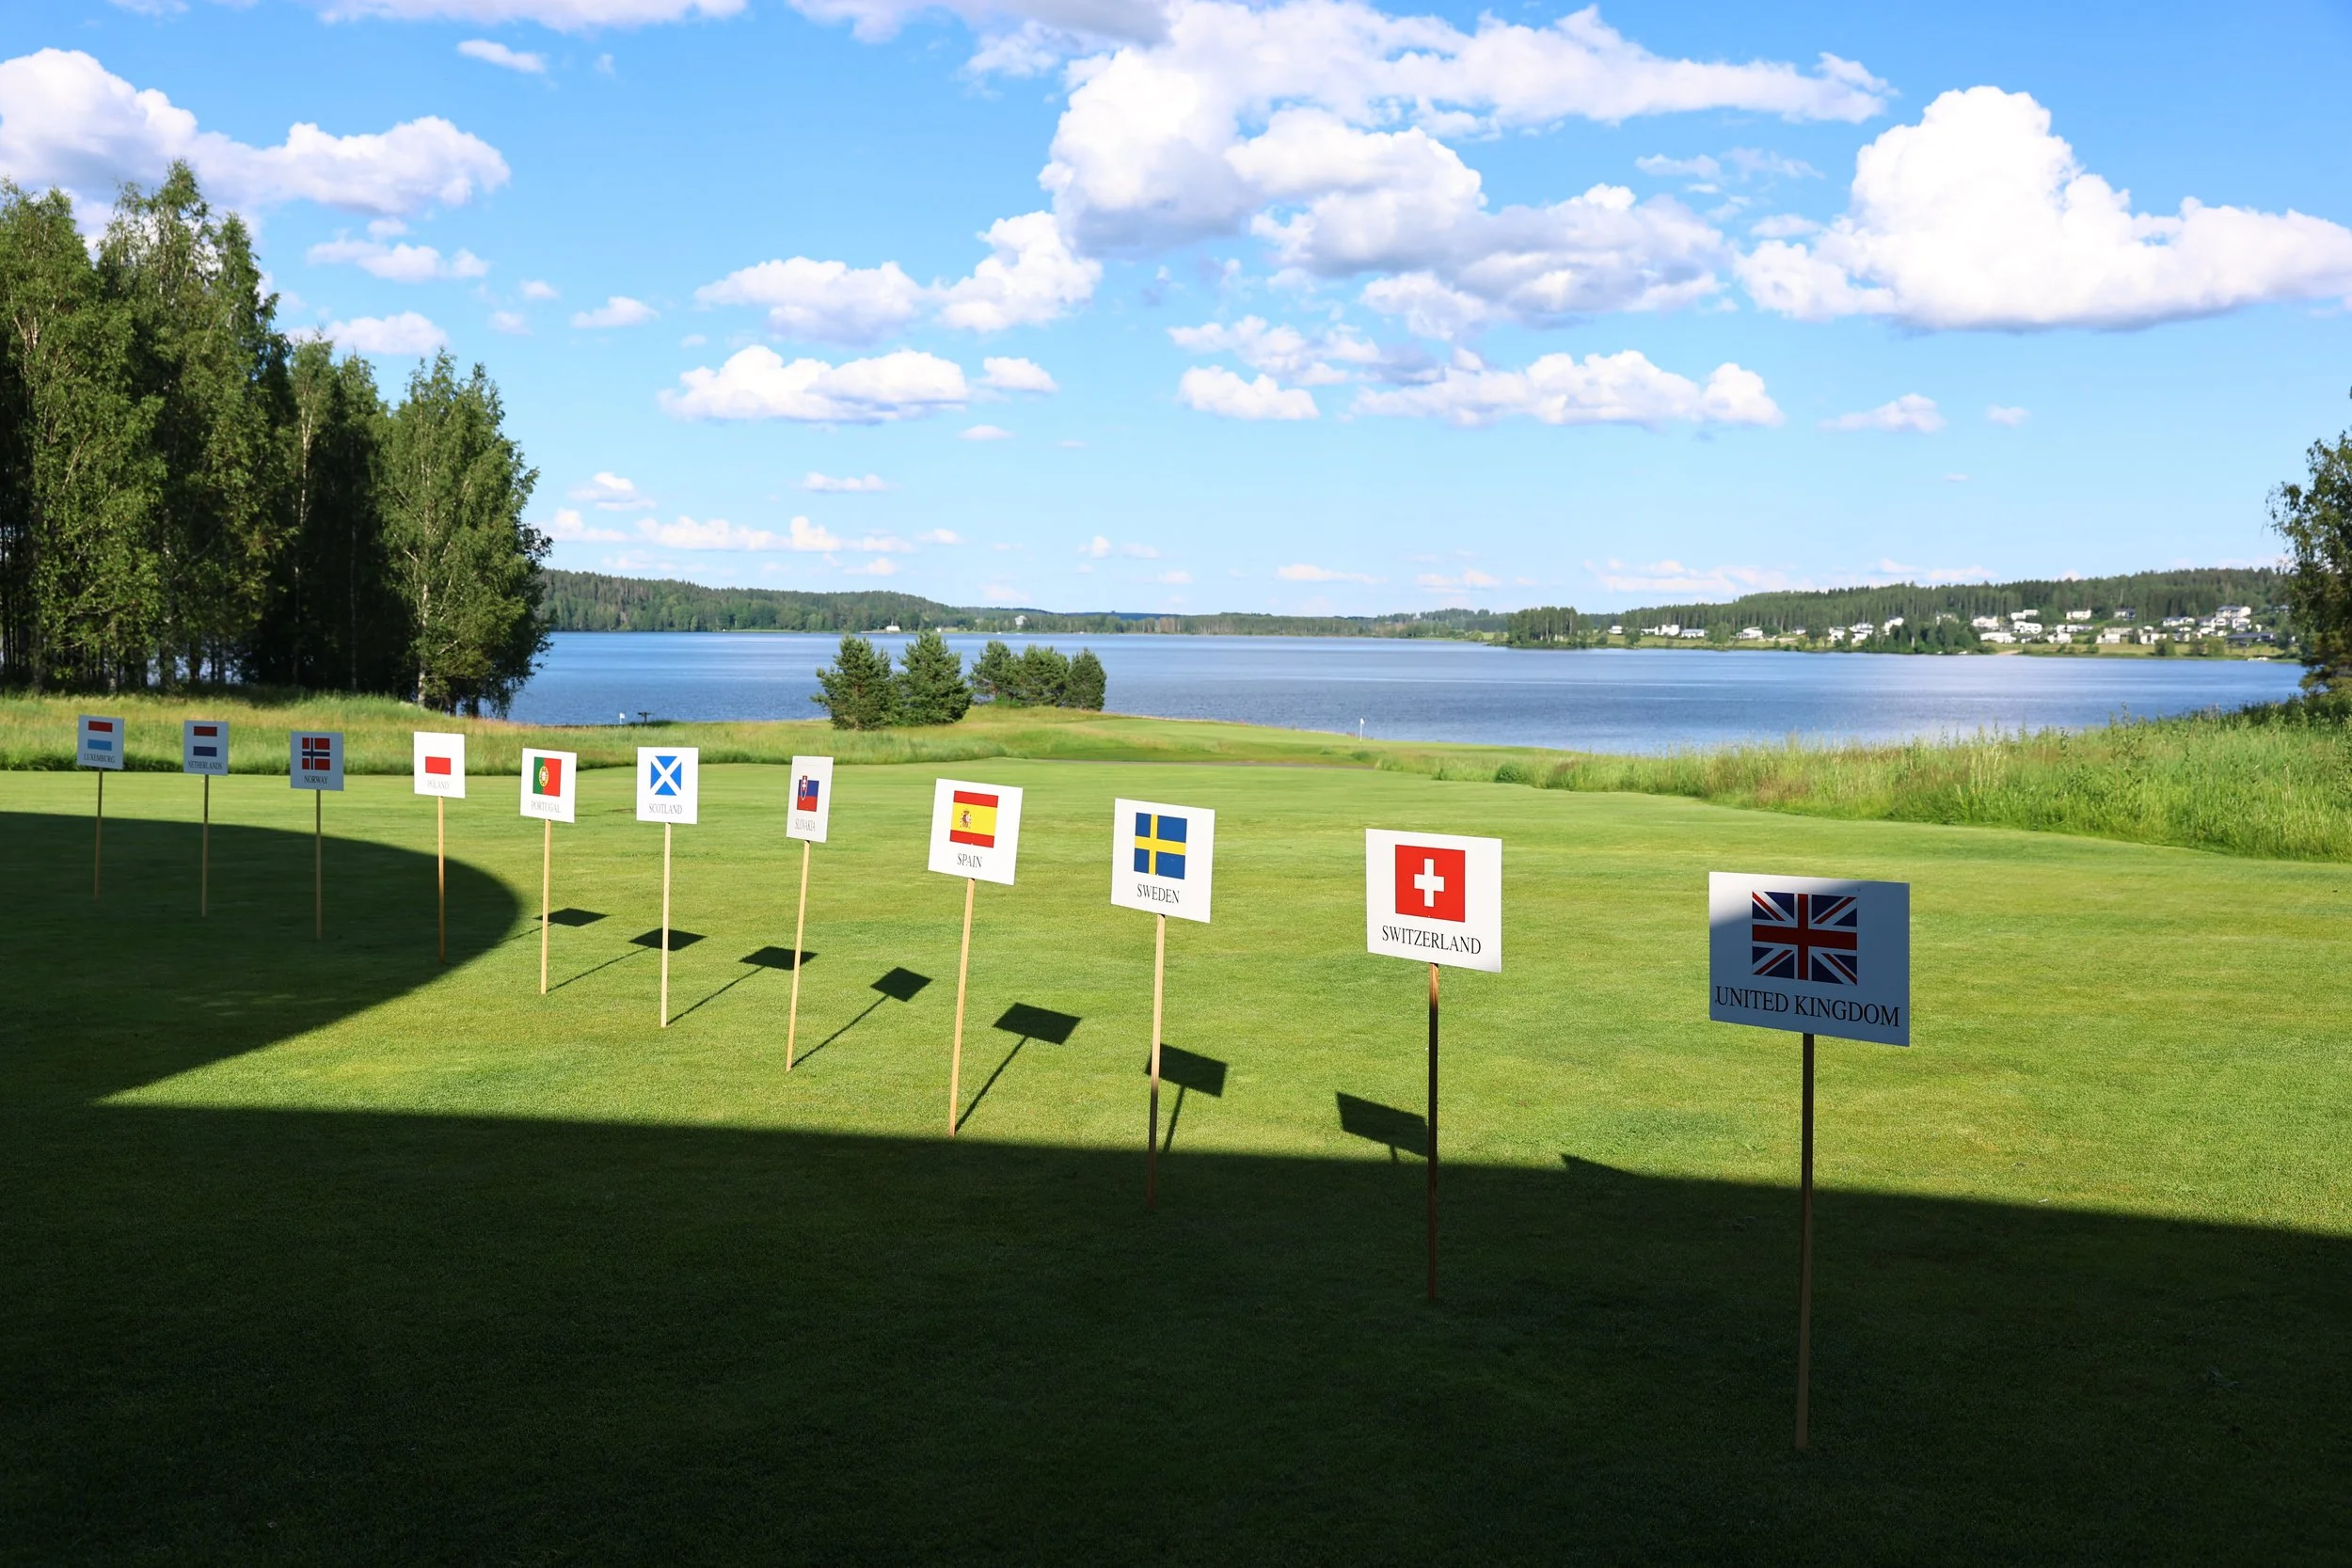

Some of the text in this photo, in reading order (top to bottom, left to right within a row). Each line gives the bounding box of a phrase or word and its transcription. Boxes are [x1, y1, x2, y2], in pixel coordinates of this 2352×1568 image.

[304, 775, 328, 784] NORWAY
[427, 779, 449, 789] POLAND
[532, 800, 561, 813] PORTUGAL
[648, 803, 682, 815] SCOTLAND
[795, 818, 816, 832] SLOVAKIA
[957, 853, 982, 868] SPAIN
[1136, 883, 1180, 904] SWEDEN
[1382, 925, 1481, 955] SWITZERLAND
[1716, 986, 1900, 1027] UNITED KINGDOM
